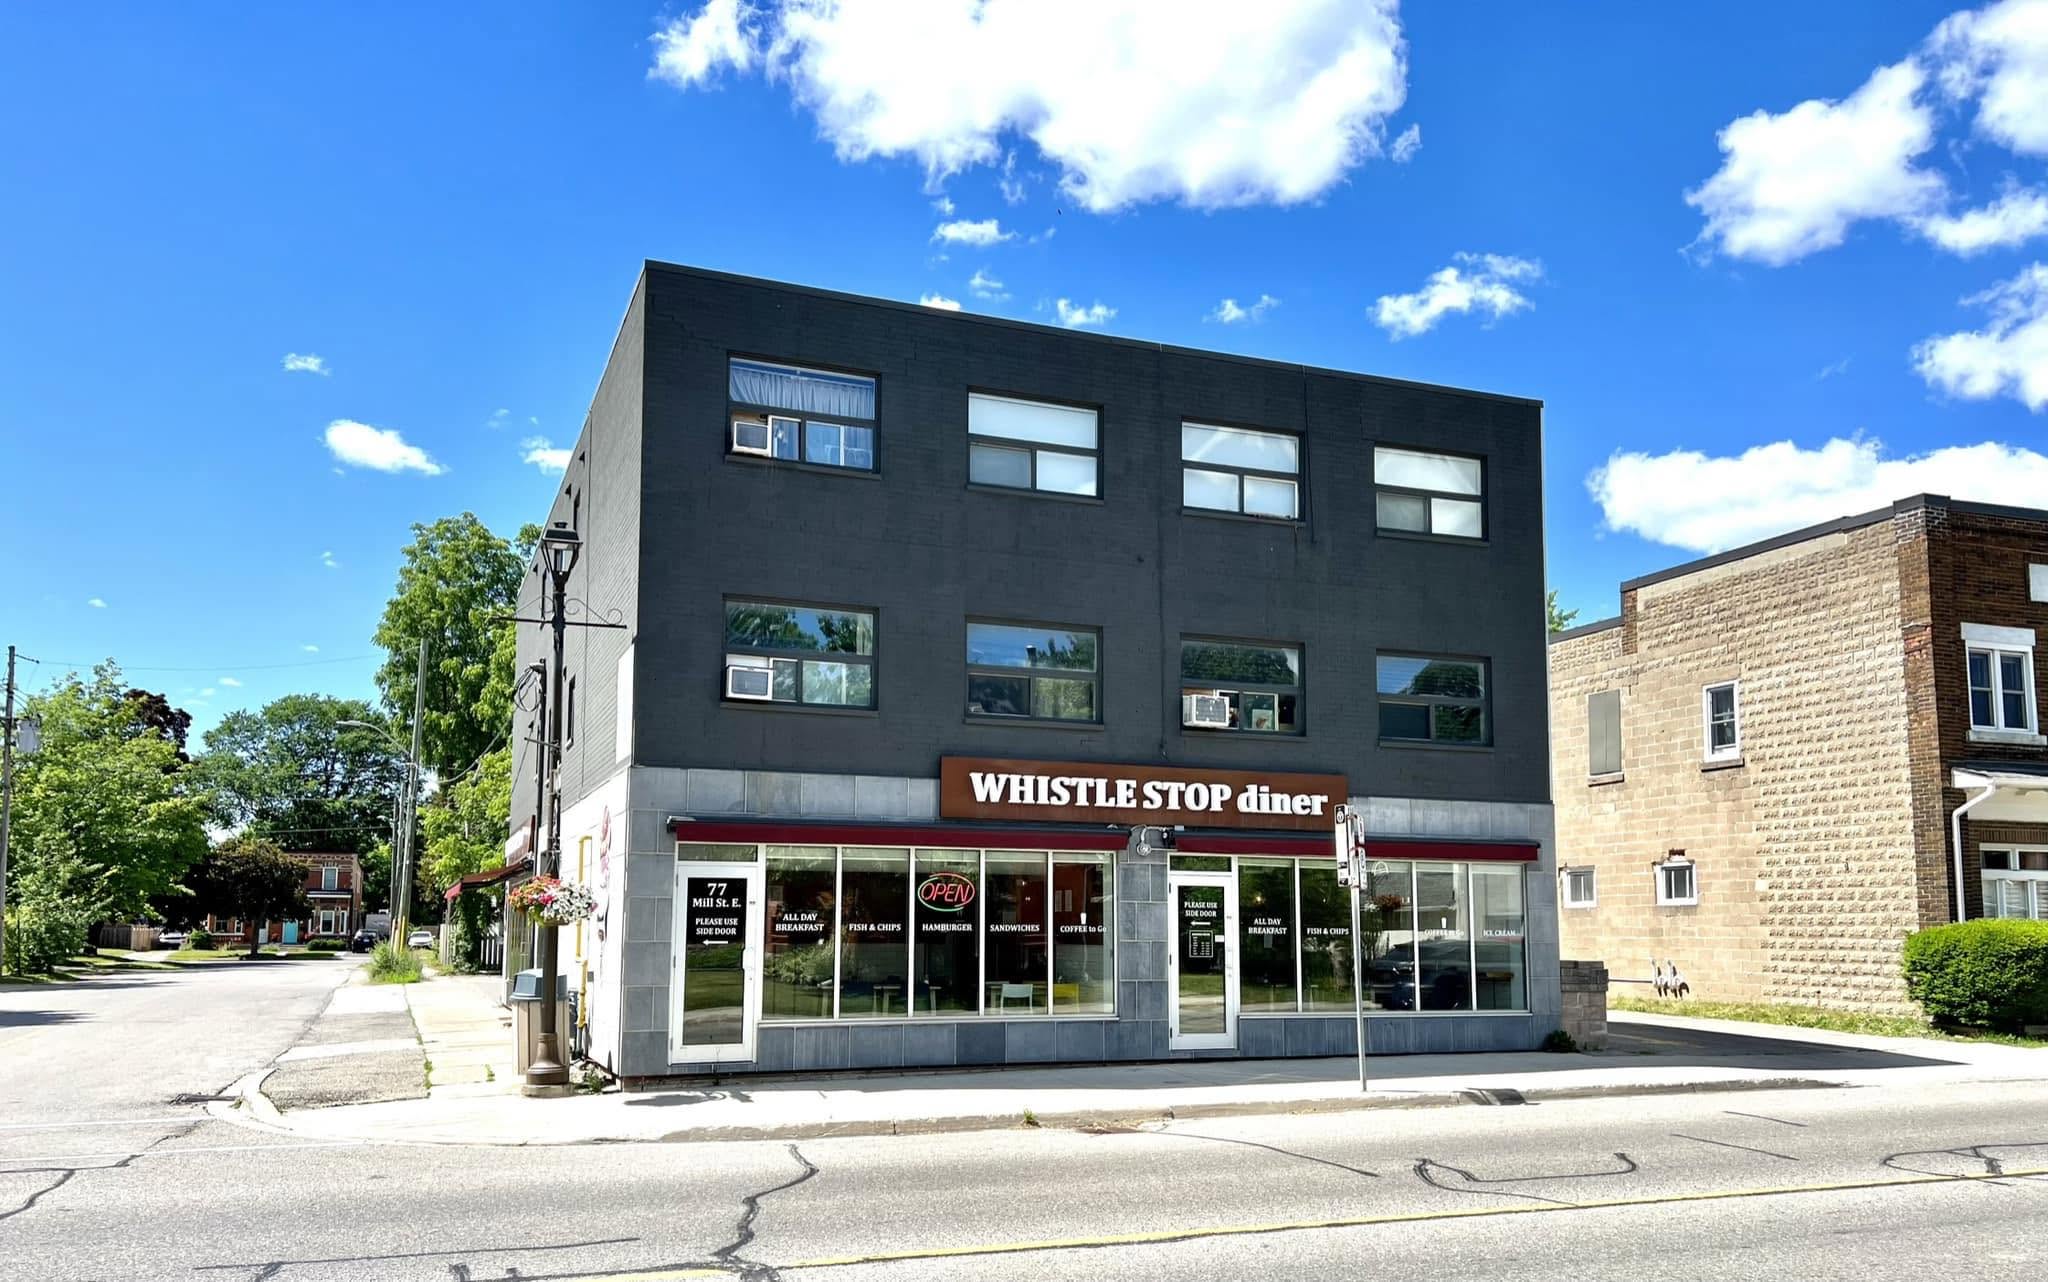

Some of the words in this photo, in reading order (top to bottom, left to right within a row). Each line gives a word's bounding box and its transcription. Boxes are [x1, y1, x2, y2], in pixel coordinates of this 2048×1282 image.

[969, 772, 1137, 809] WHISTLE
[1142, 781, 1232, 811] STOP
[1237, 785, 1328, 815] diner
[707, 883, 727, 896] 77
[921, 882, 970, 902] OPEN
[692, 898, 713, 908] Mill
[716, 898, 729, 908] St.
[732, 898, 741, 908] E.
[1184, 901, 1205, 909] PLEASE
[783, 913, 799, 921] ALL
[800, 913, 818, 921] DAY
[1185, 910, 1199, 918] SIDE
[695, 918, 723, 926] PLEASE
[724, 918, 738, 926] USE
[1254, 918, 1267, 926] ALL
[696, 927, 713, 936] SIDE
[714, 927, 737, 936] DOOR
[775, 923, 824, 932] BREAKFAST
[849, 923, 868, 932] FISH
[869, 923, 875, 932] &
[877, 923, 901, 932] CHIPS
[922, 923, 973, 932] HAMBURGER
[990, 924, 1040, 933] SANDWICHES
[1060, 925, 1088, 933] COFFEE
[1097, 925, 1107, 933] Go
[1248, 927, 1288, 935] BREAKFAST
[1307, 927, 1322, 935] FISH
[1323, 927, 1329, 935] &
[1329, 927, 1349, 935] CHIPS
[1483, 929, 1494, 937] ICE
[1494, 929, 1516, 937] CREAM
